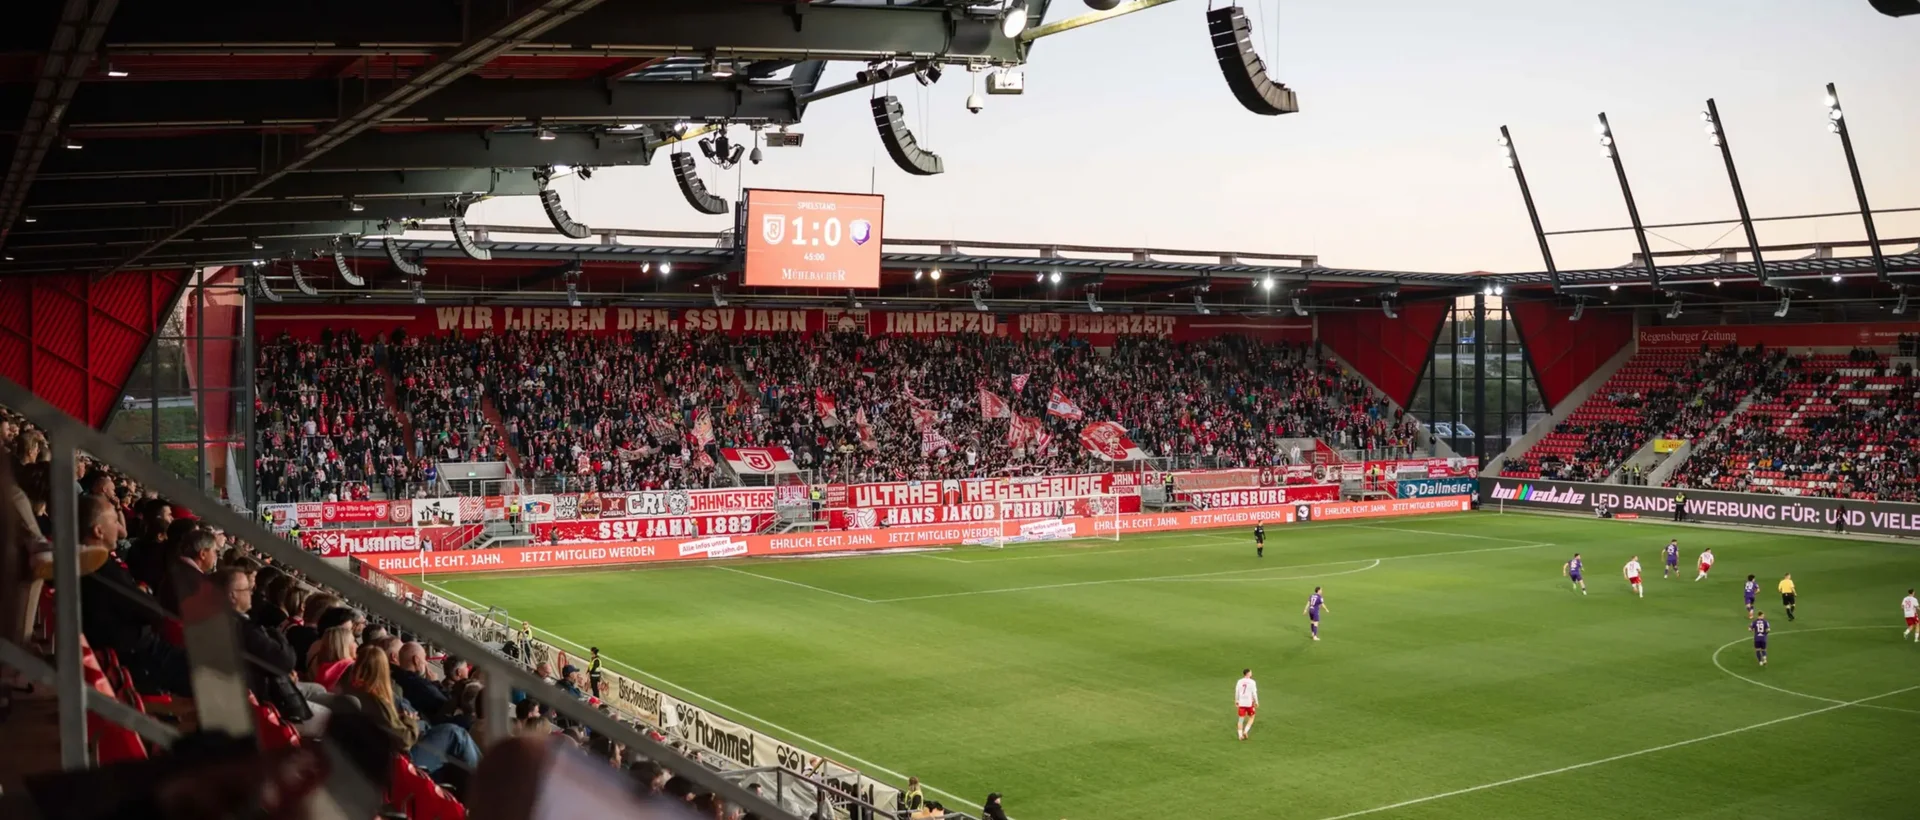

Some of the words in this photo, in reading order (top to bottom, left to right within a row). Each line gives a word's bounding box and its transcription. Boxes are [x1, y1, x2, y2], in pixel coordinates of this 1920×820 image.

[797, 202, 837, 210] SPIELSTAND
[791, 216, 841, 246] 1:0
[804, 252, 825, 261] 45:00
[436, 307, 493, 330] WIR
[504, 308, 607, 331] LIEBEN
[617, 308, 670, 331] DEN
[684, 309, 735, 331] SSV
[743, 309, 807, 331] JAHN
[885, 312, 995, 334] IMMERZU
[1019, 314, 1062, 333] UND
[1069, 314, 1177, 334] JEDERZEIT
[1640, 332, 1699, 343] Regensburger
[1702, 330, 1737, 342] Zeitung
[855, 482, 938, 507] ULTRAS
[966, 476, 1103, 502] REGENSBURG
[1193, 489, 1286, 508] REGENSBURG
[690, 492, 774, 511] JAHNGSTERS
[1392, 502, 1409, 511] JETZT
[1409, 500, 1436, 510] MITGLIED
[1436, 499, 1459, 508] WERDEN
[1591, 492, 1619, 508] LED
[1780, 502, 1821, 523] FÜR:
[1825, 508, 1866, 526] UND
[887, 507, 935, 524] HANS
[942, 504, 995, 522] JAKOB
[1003, 500, 1075, 518] TRIBUNE
[1190, 514, 1212, 525] JETZT
[1213, 512, 1248, 523] MITGLIED
[1249, 510, 1281, 521] WERDEN
[598, 521, 639, 539] SSV
[646, 518, 698, 537] JAHN
[706, 516, 752, 533] 1889
[1132, 518, 1155, 529] ECHT.
[1157, 516, 1179, 527] JAHN.
[341, 528, 420, 553] hummel
[770, 539, 815, 549] EHRLICH.
[817, 536, 846, 546] ECHT.
[848, 534, 875, 545] JAHN.
[888, 532, 914, 543] JETZT
[917, 529, 960, 541] MITGLIED
[962, 527, 1000, 539] WERDEN
[379, 557, 432, 570] EHRLICH.
[434, 555, 468, 568] ECHT.
[469, 553, 504, 565] JAHN.
[520, 551, 552, 563] JETZT
[555, 548, 606, 561] MITGLIED
[608, 546, 655, 559] WERDEN
[1756, 623, 1765, 632] 19
[1242, 684, 1248, 695] 7
[695, 710, 755, 768] hummel
